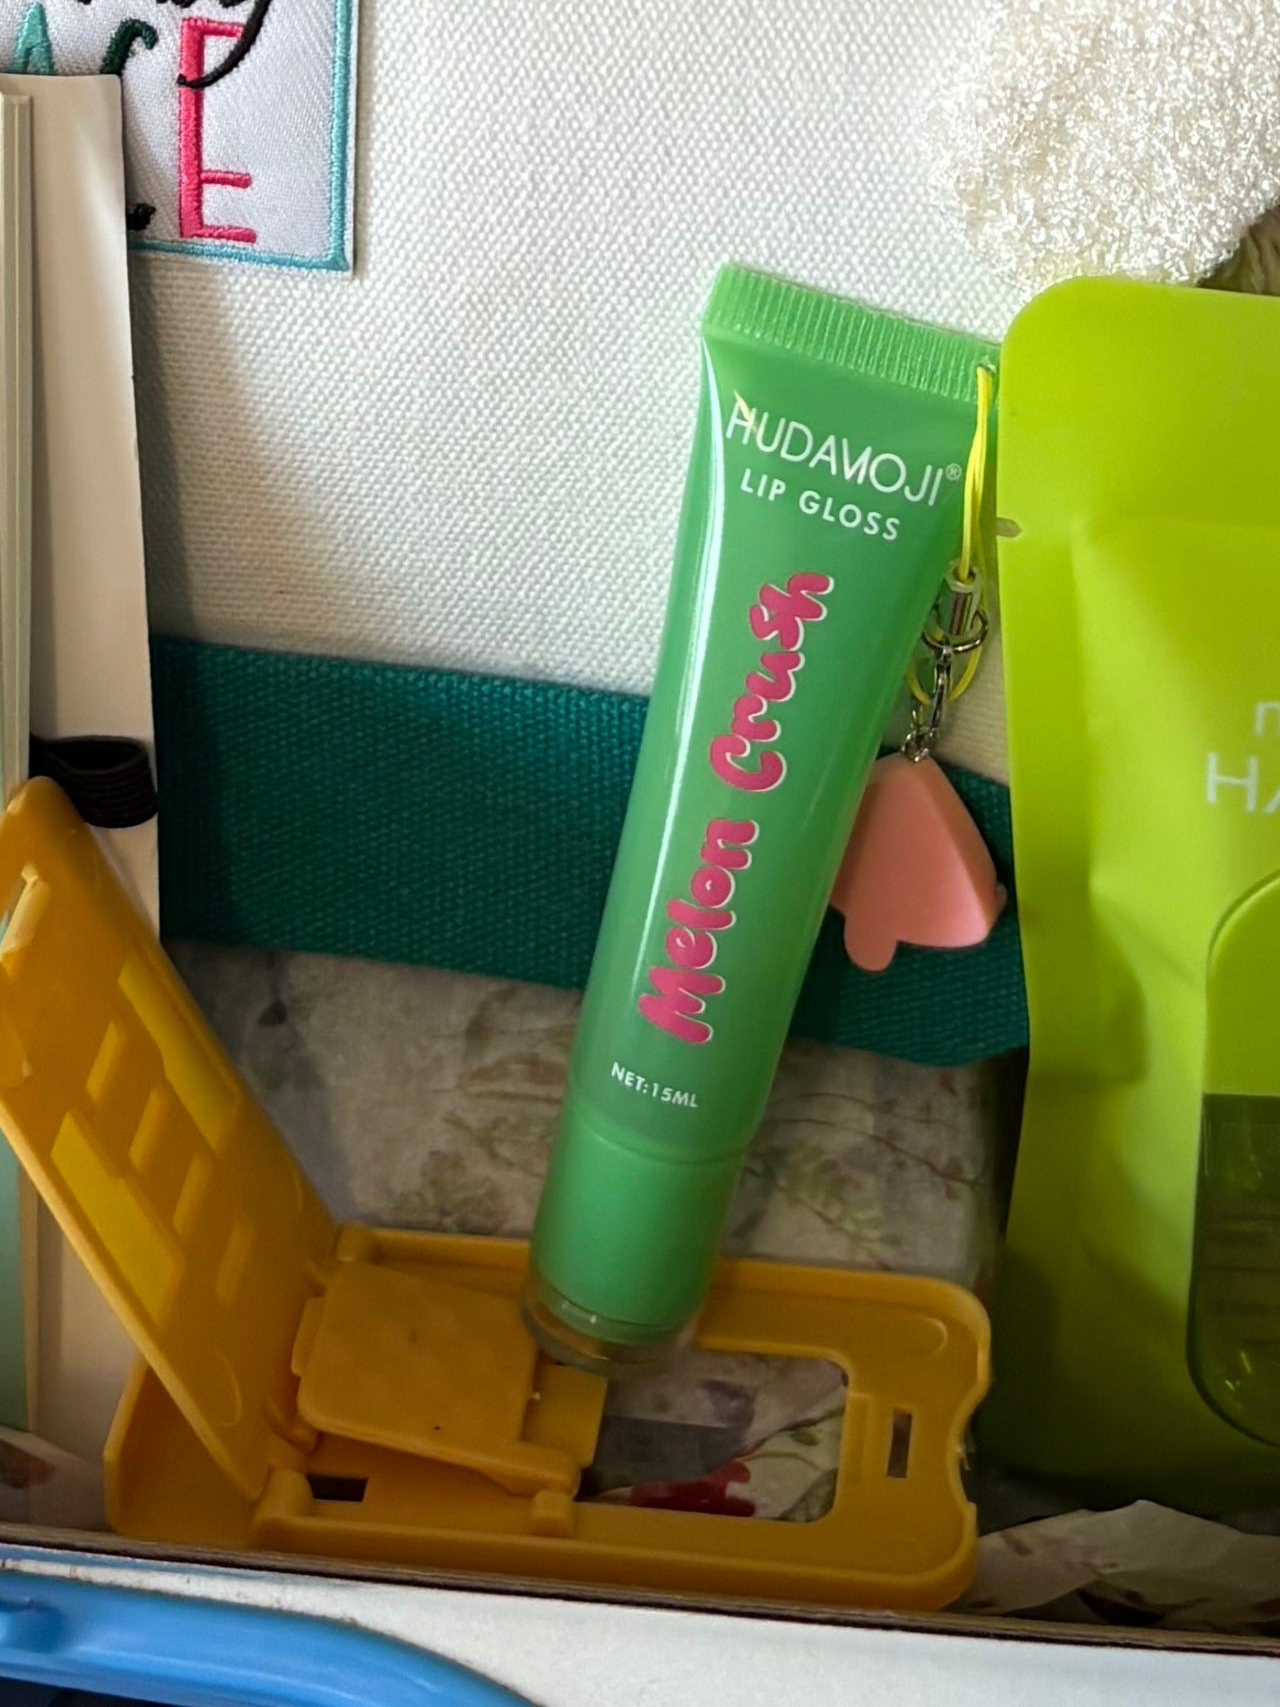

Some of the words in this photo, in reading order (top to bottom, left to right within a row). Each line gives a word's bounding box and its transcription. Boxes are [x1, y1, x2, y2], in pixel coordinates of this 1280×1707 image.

[739, 467, 787, 501] LIP
[798, 489, 900, 542] GLOSS
[637, 816, 762, 1047] Melon
[708, 569, 837, 793] Crush
